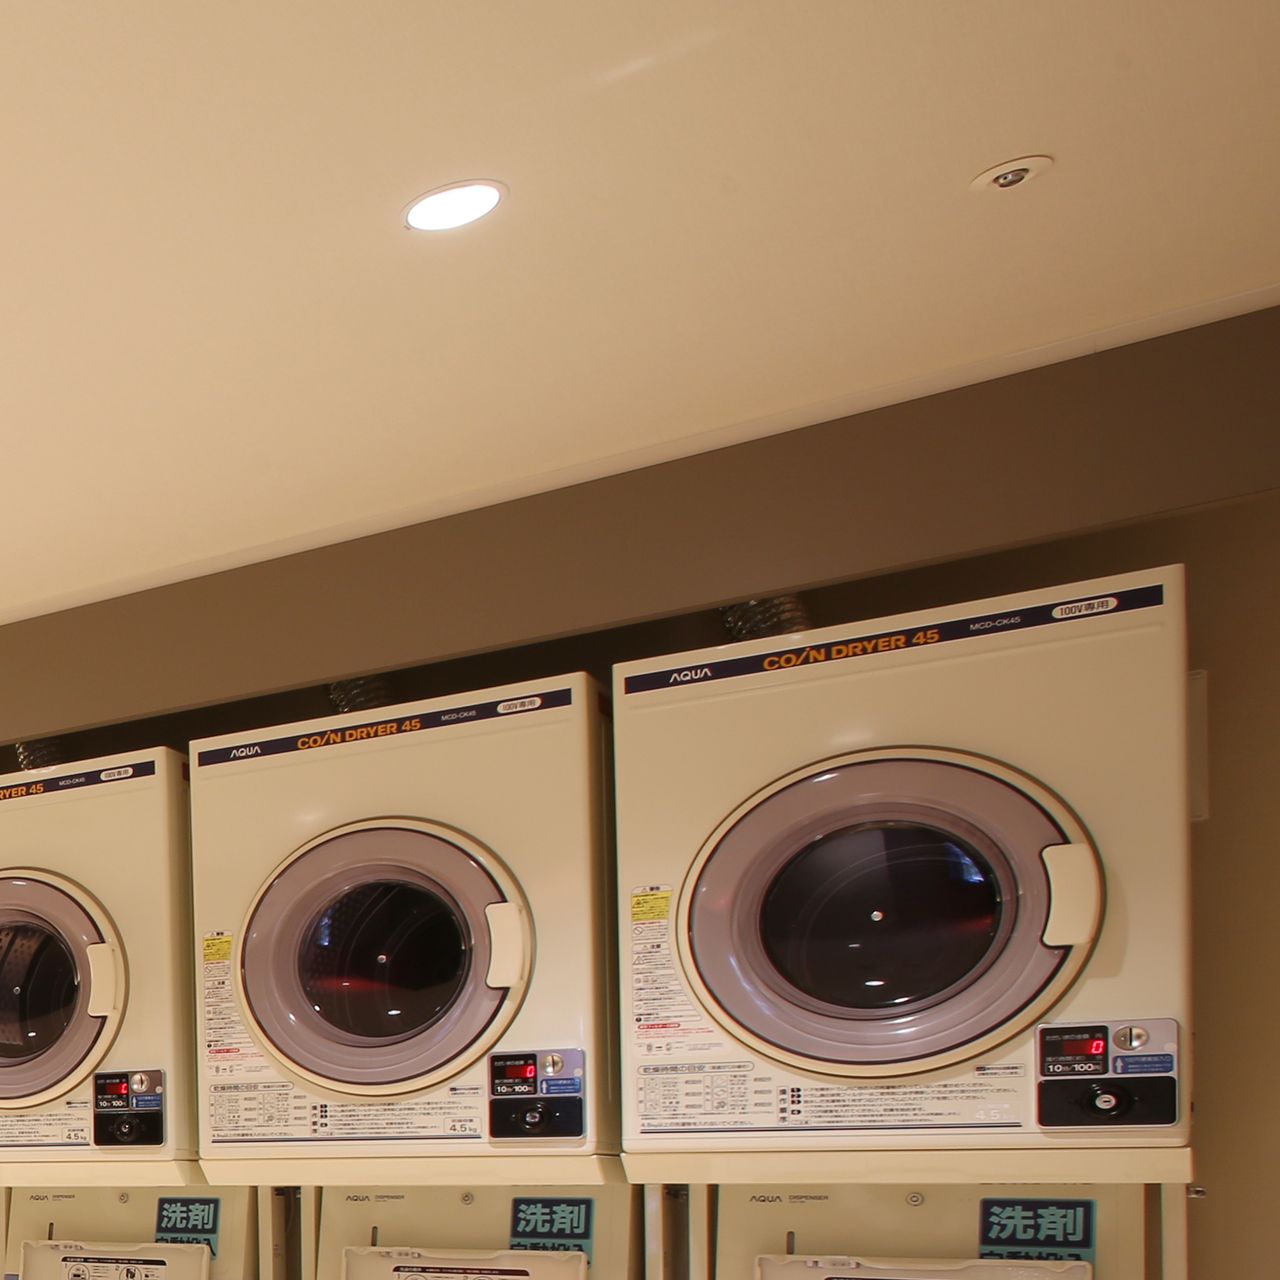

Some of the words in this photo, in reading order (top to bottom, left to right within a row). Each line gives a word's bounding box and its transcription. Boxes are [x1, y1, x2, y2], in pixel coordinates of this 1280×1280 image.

[832, 634, 907, 661] DRYER
[912, 629, 939, 646] 45
[669, 667, 712, 683] AQUA
[344, 723, 398, 742] DRYER
[401, 719, 421, 732] 45
[230, 746, 261, 758] AQUA
[29, 783, 44, 795] 45
[1091, 1040, 1104, 1054] 0
[527, 1066, 535, 1077] 0
[749, 1195, 783, 1203] AQUA
[161, 1203, 214, 1229] 洗剤
[516, 1203, 586, 1234] 洗剤
[988, 1206, 1084, 1241] 洗剤
